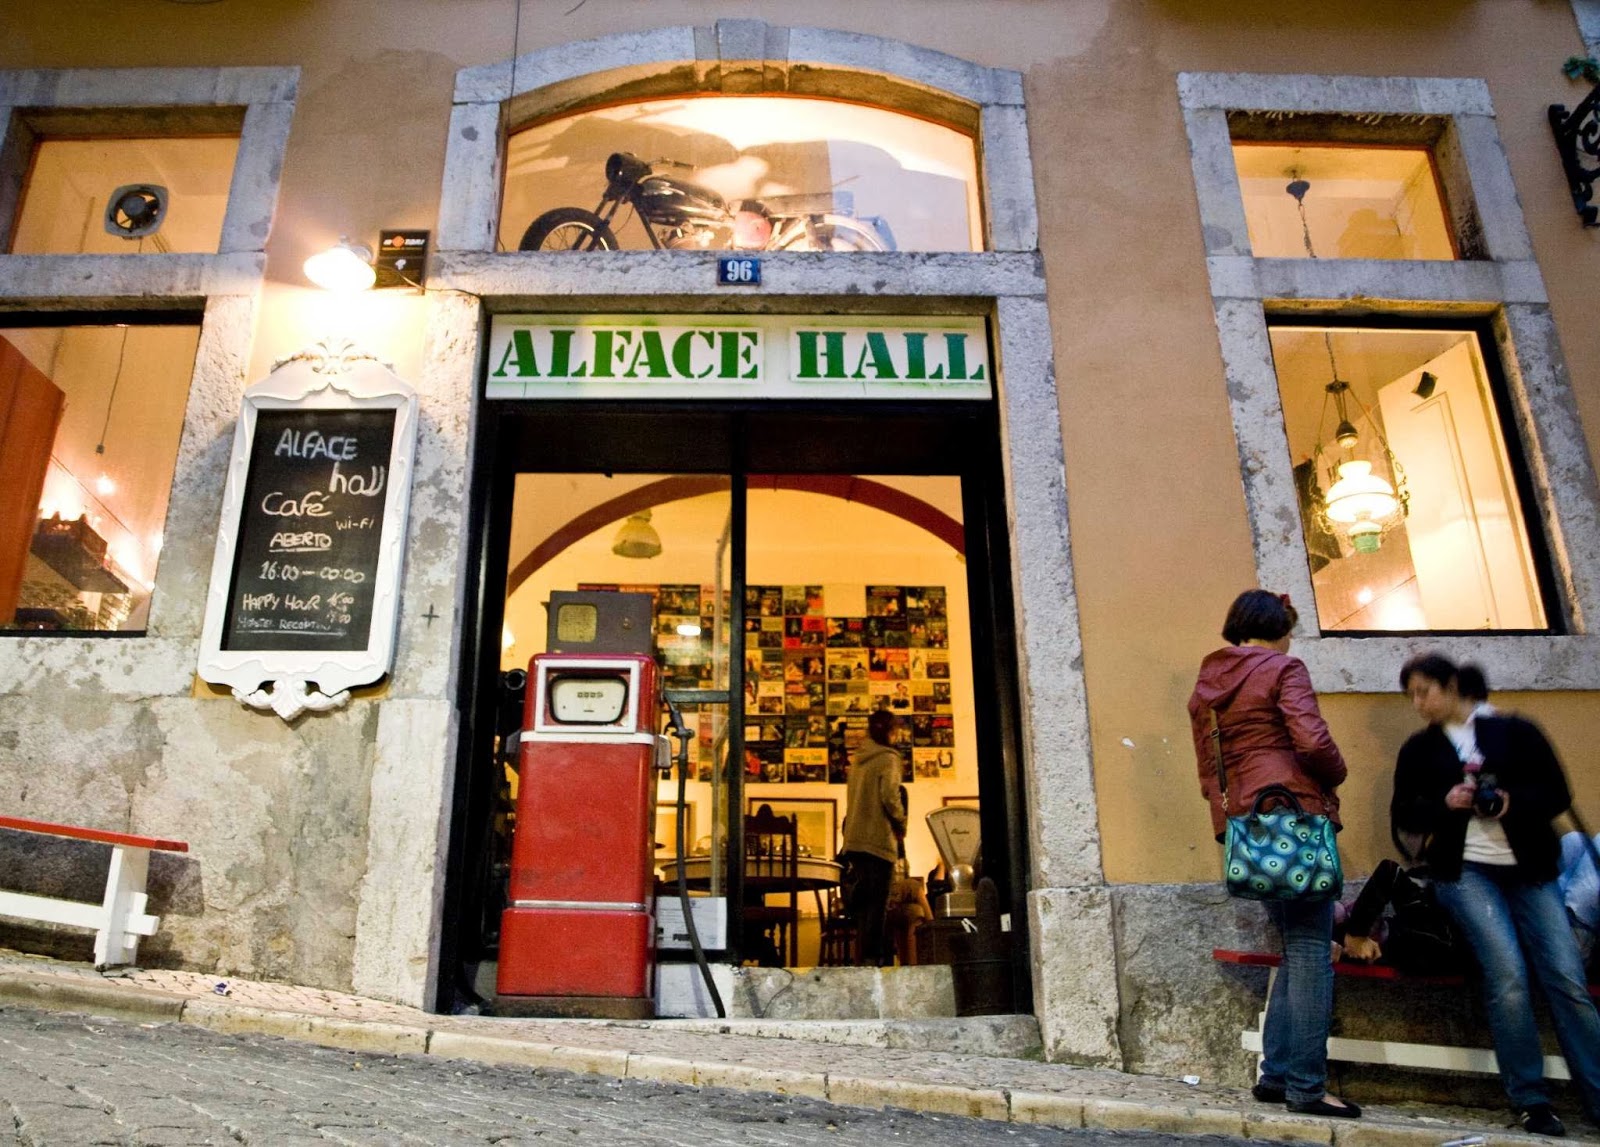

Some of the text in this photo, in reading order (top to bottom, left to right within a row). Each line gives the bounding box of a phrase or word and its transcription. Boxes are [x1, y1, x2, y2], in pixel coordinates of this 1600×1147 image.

[727, 260, 752, 282] 96
[492, 329, 985, 380] ALFACE HALL
[274, 427, 358, 460] ALFACE
[328, 461, 385, 496] hall
[261, 491, 333, 516] Café
[269, 531, 332, 549] ABERTO
[242, 592, 280, 611] HAPPY
